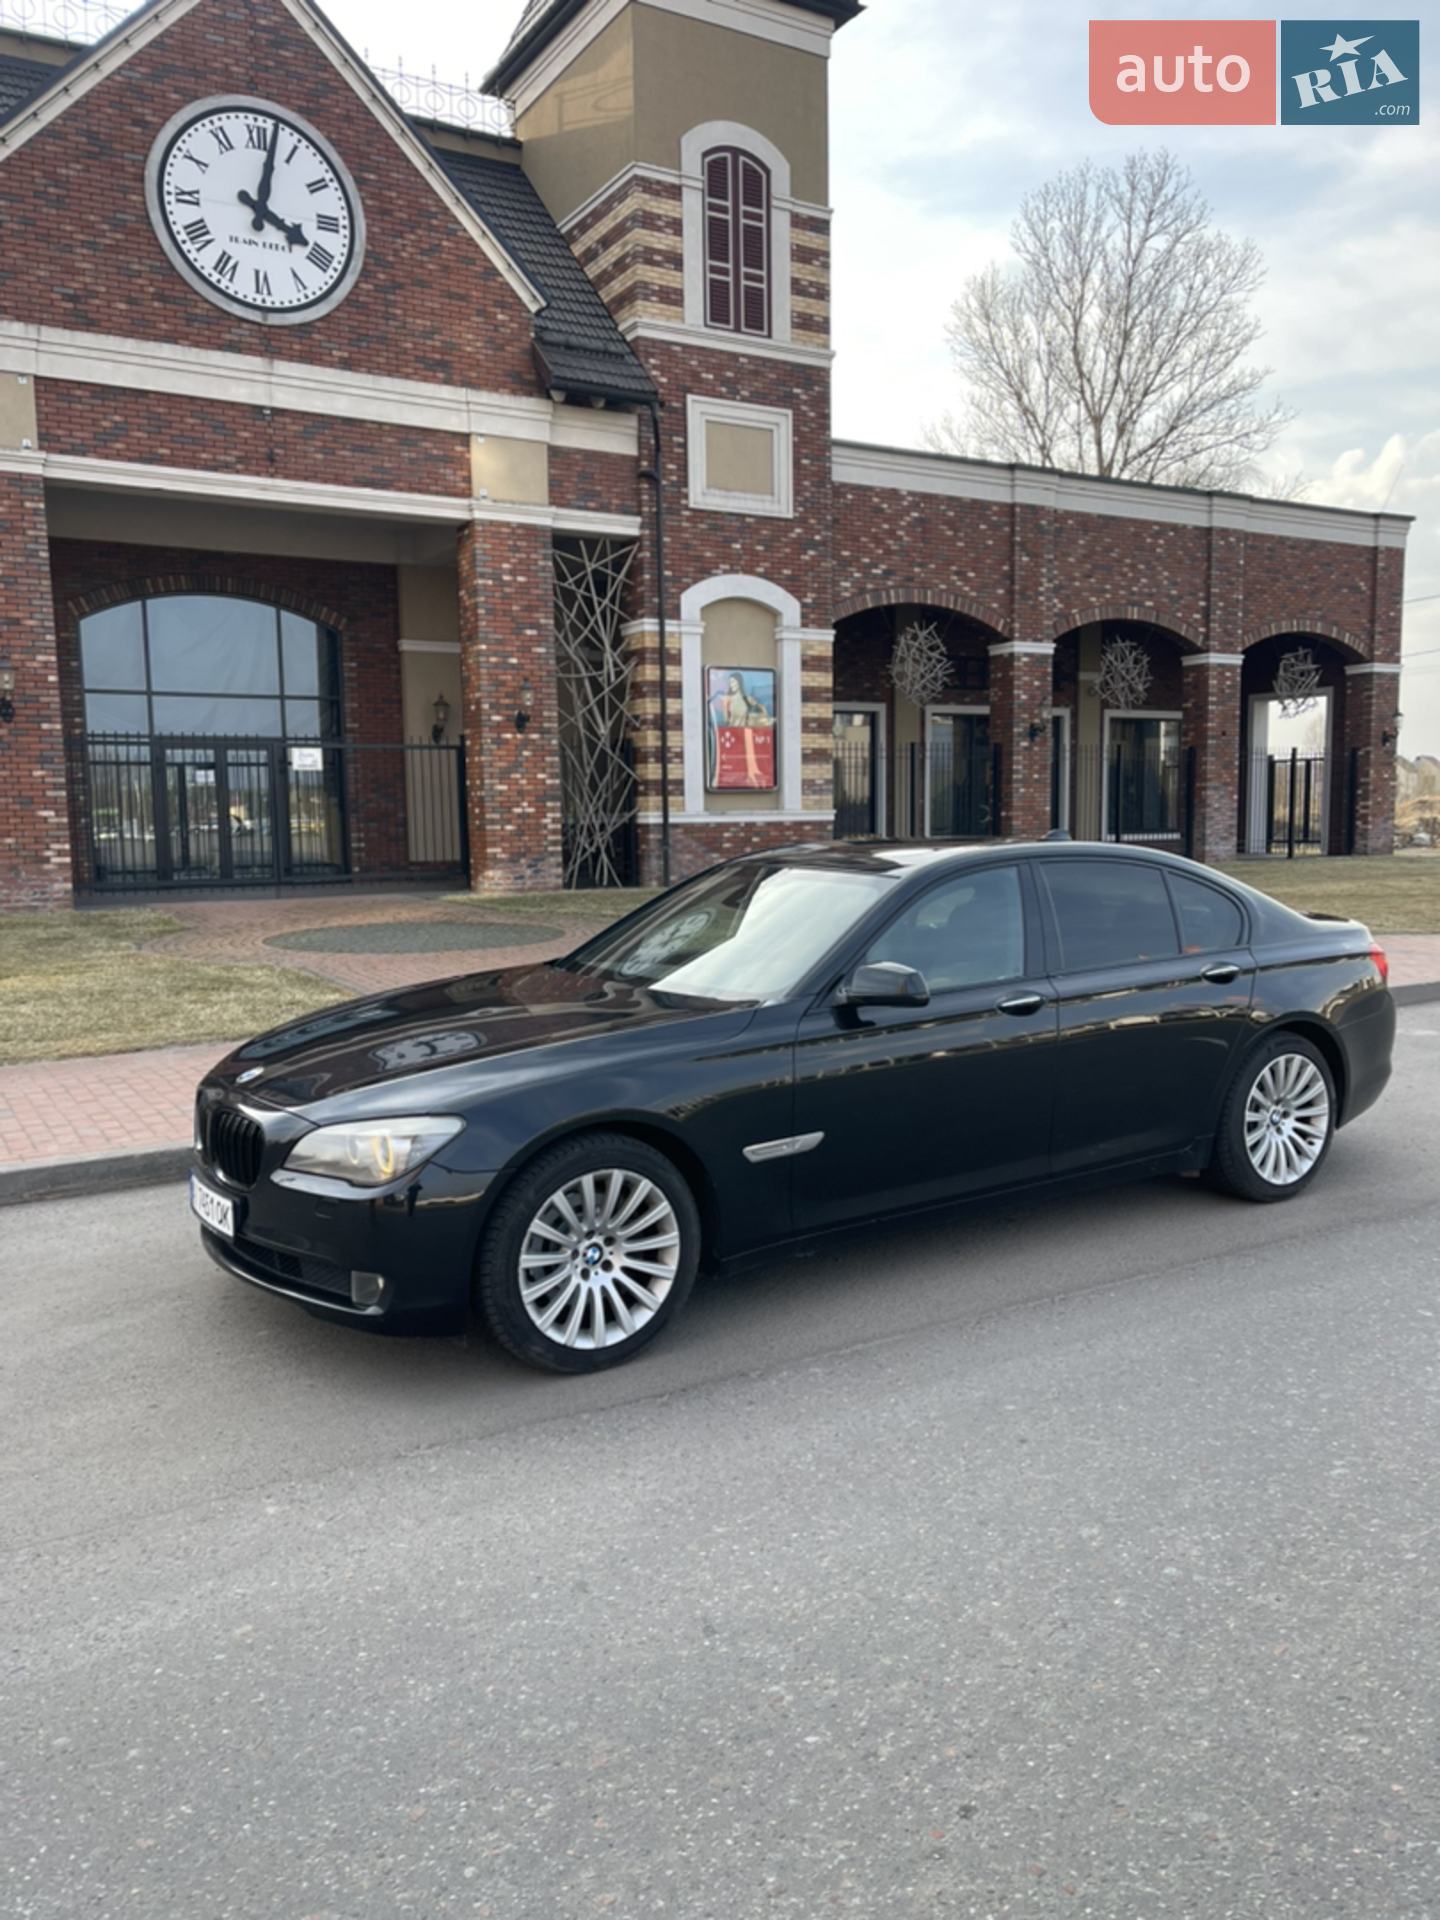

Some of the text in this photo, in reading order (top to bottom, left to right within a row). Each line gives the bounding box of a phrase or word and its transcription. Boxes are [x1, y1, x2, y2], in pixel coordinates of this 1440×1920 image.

[209, 125, 235, 155] XI
[245, 124, 267, 151] XII
[182, 149, 209, 174] X
[316, 213, 340, 234] III
[254, 268, 272, 297] VI
